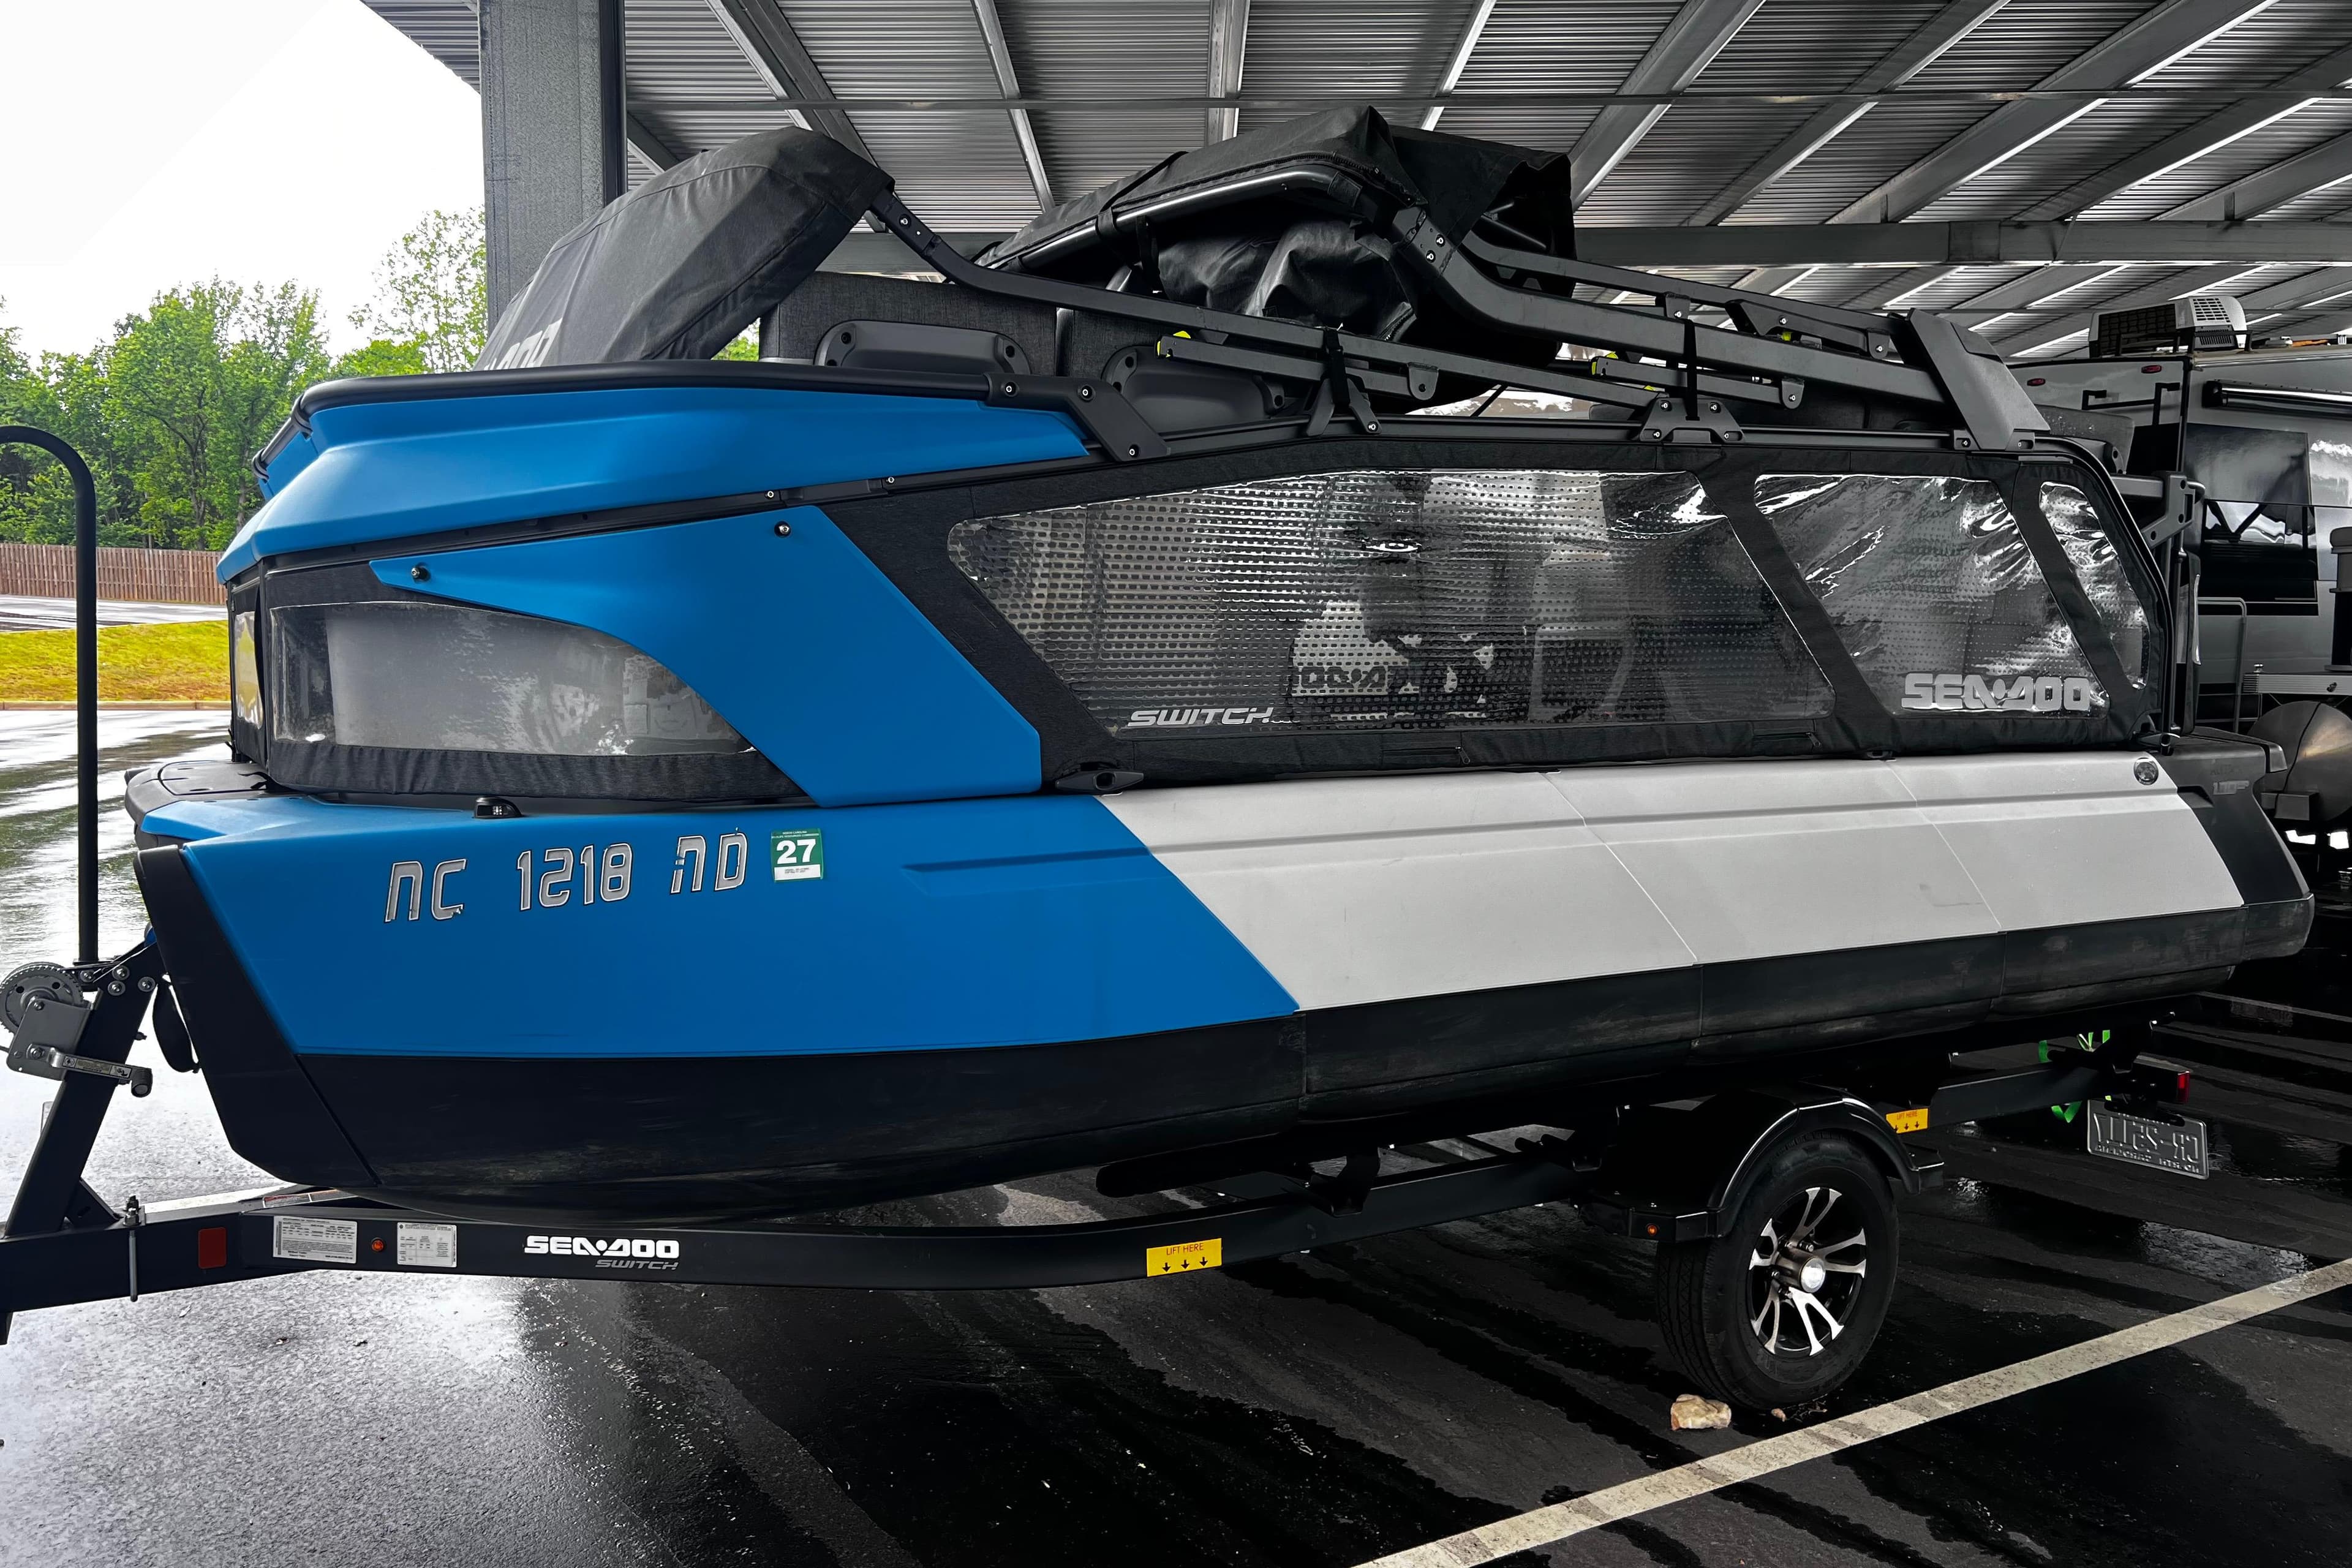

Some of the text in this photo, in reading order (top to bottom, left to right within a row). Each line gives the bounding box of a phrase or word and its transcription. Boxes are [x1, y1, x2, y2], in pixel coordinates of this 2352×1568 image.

[1127, 707, 1274, 726] SWITCH
[776, 839, 816, 865] 27
[385, 832, 747, 922] NC 1218 ND
[1166, 1243, 1204, 1256] LIFT HERE
[595, 1259, 679, 1270] SWITCH
